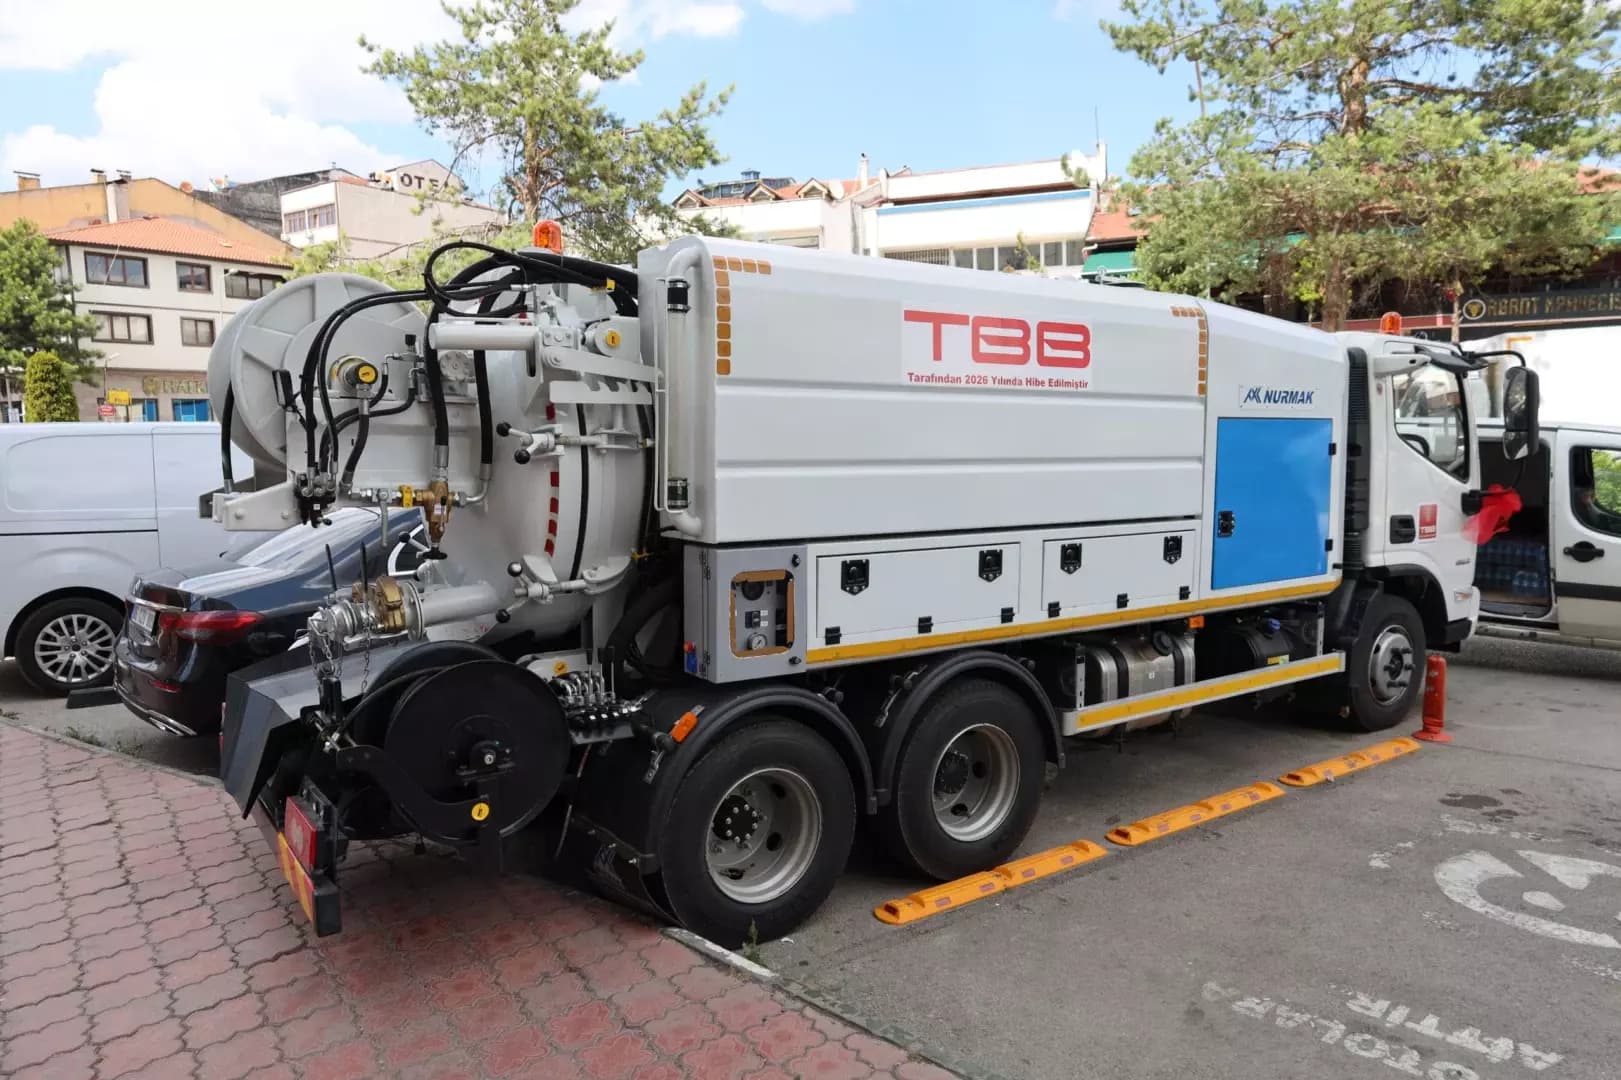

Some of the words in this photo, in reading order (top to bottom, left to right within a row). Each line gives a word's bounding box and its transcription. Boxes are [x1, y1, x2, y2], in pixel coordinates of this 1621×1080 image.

[904, 310, 1091, 369] TBB
[907, 372, 962, 385] Tarafından
[965, 374, 988, 386] 2026
[991, 376, 1023, 387] Yılında
[1025, 377, 1046, 388] Hibe
[1048, 379, 1089, 390] Edilmiştir
[1264, 389, 1314, 404] NURMAK
